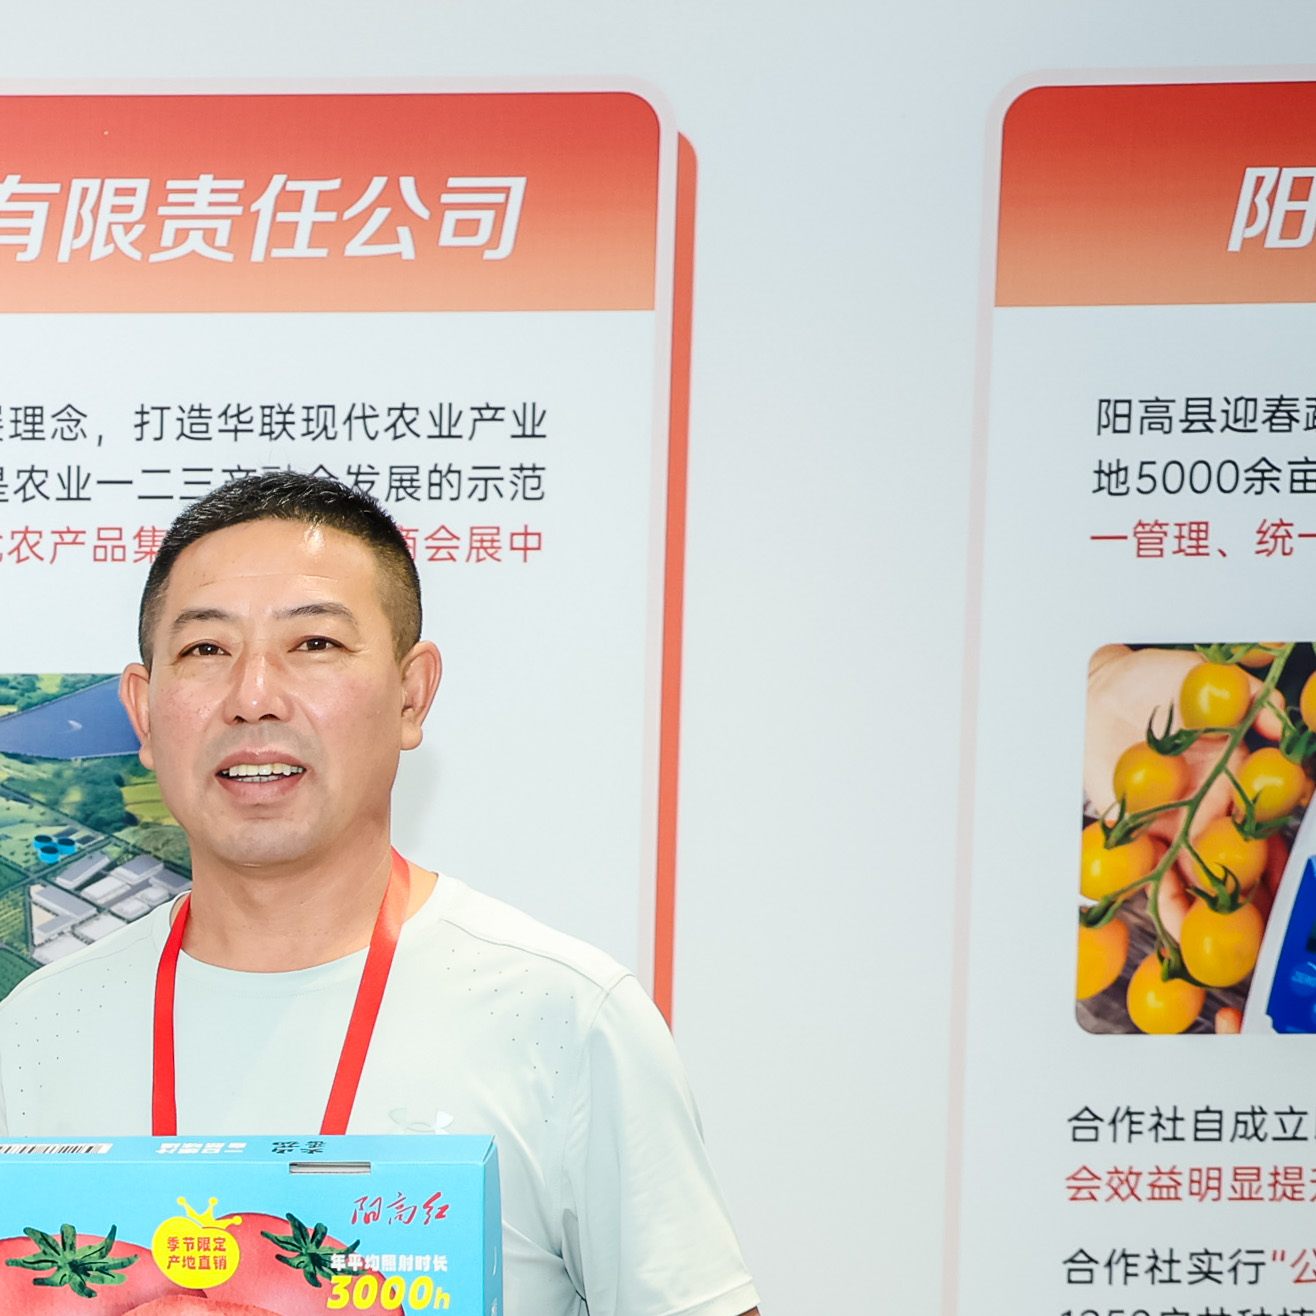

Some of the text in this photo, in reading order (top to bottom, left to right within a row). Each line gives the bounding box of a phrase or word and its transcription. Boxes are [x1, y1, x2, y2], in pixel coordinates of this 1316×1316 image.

[1067, 1105, 1316, 1143] 合作社自成立
[326, 1274, 451, 1311] 3000h
